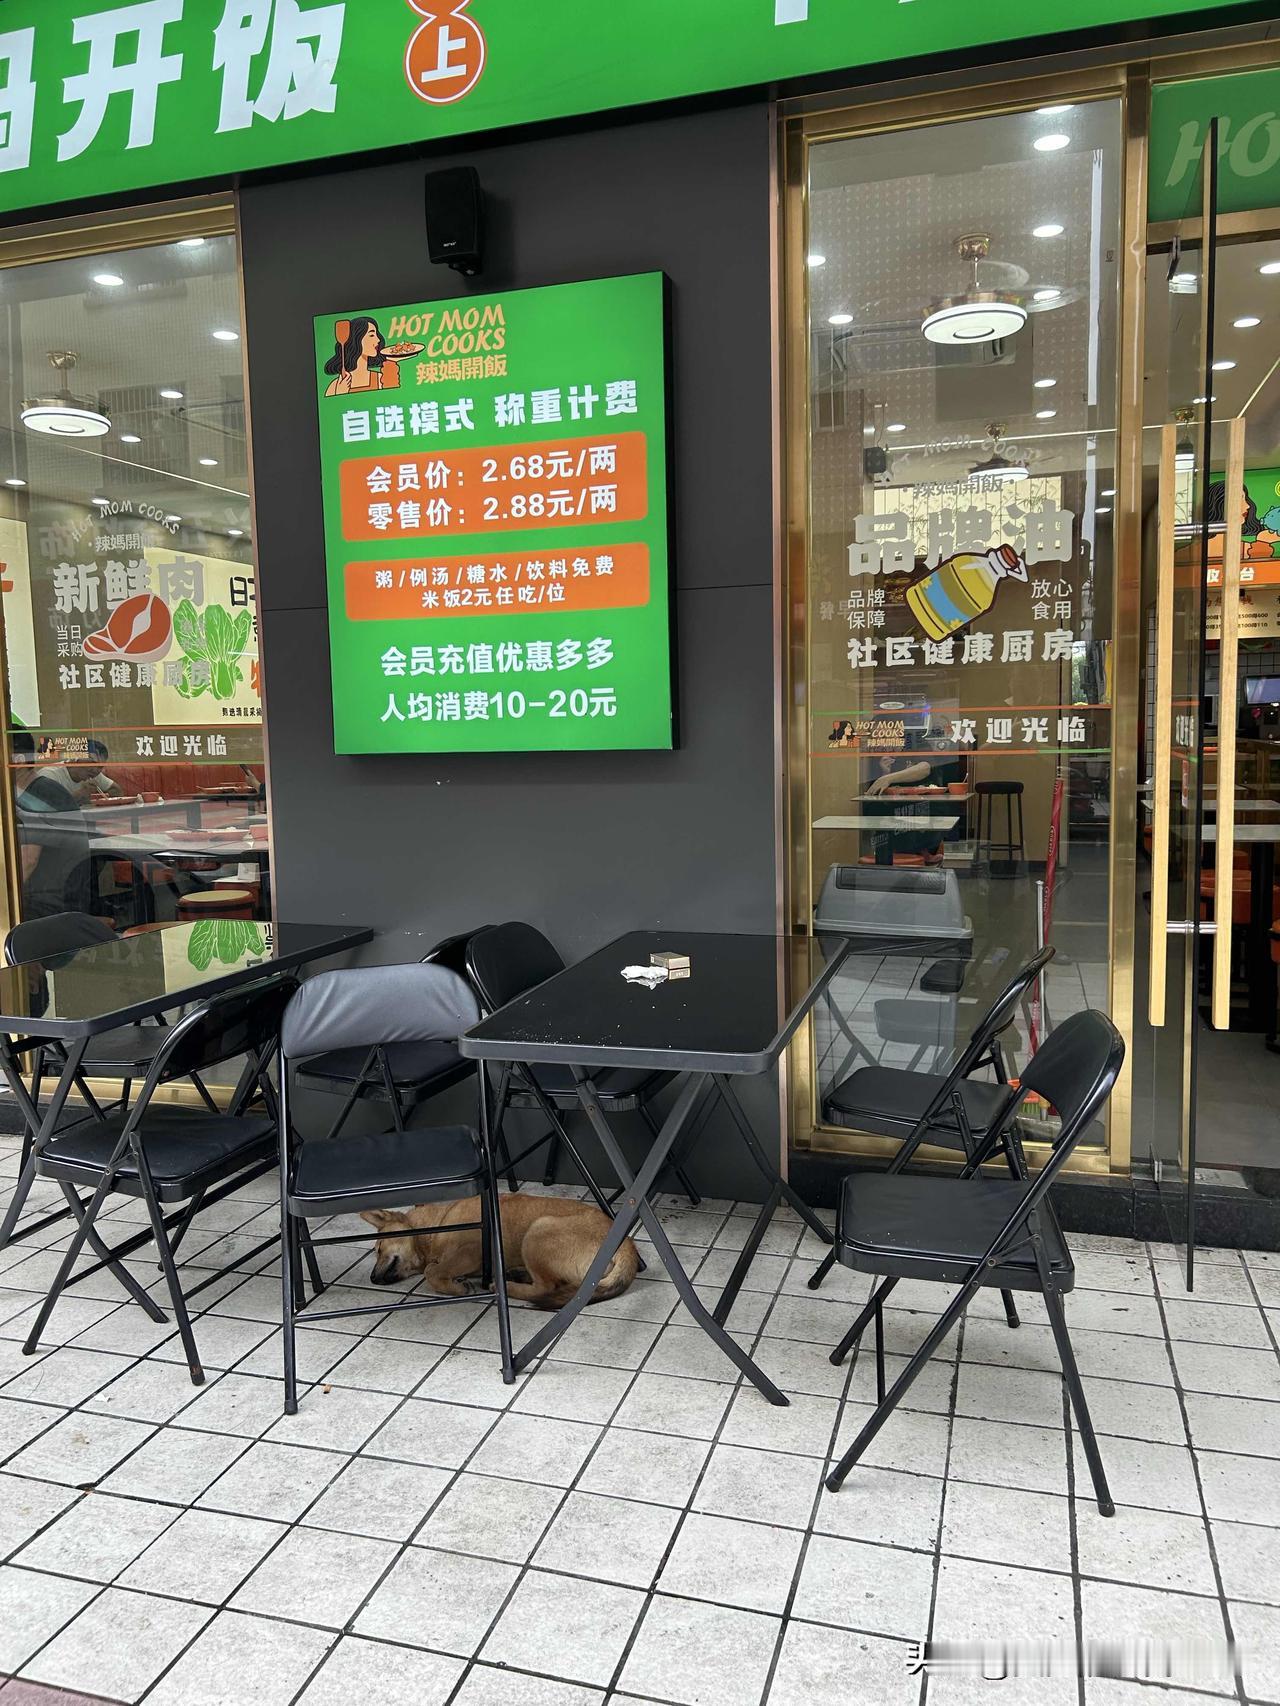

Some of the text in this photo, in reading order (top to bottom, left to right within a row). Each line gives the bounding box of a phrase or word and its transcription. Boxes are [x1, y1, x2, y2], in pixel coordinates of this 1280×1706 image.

[420, 24, 468, 84] 上
[388, 303, 506, 340] HOT MOM
[427, 327, 506, 358] COOKS
[415, 354, 508, 385] 辣媽開飯
[342, 379, 638, 443] 自选模式 称重计费
[100, 500, 133, 518] MOM
[846, 499, 1076, 577] 品牌油
[847, 588, 886, 609] 品牌
[1031, 578, 1073, 600] 放心
[847, 610, 886, 630] 保障
[1031, 601, 1073, 621] 食用
[57, 625, 82, 641] 当日
[57, 641, 84, 658] 采购
[380, 637, 615, 677] 会员充值优惠多多
[847, 628, 1075, 669] 社区健康厨房
[380, 687, 618, 723] 人均消费10-20元
[855, 720, 905, 729] HOT MOM
[872, 729, 905, 738] COOKS
[950, 717, 1086, 745] 欢迎光临
[136, 735, 228, 757] 欢迎光临
